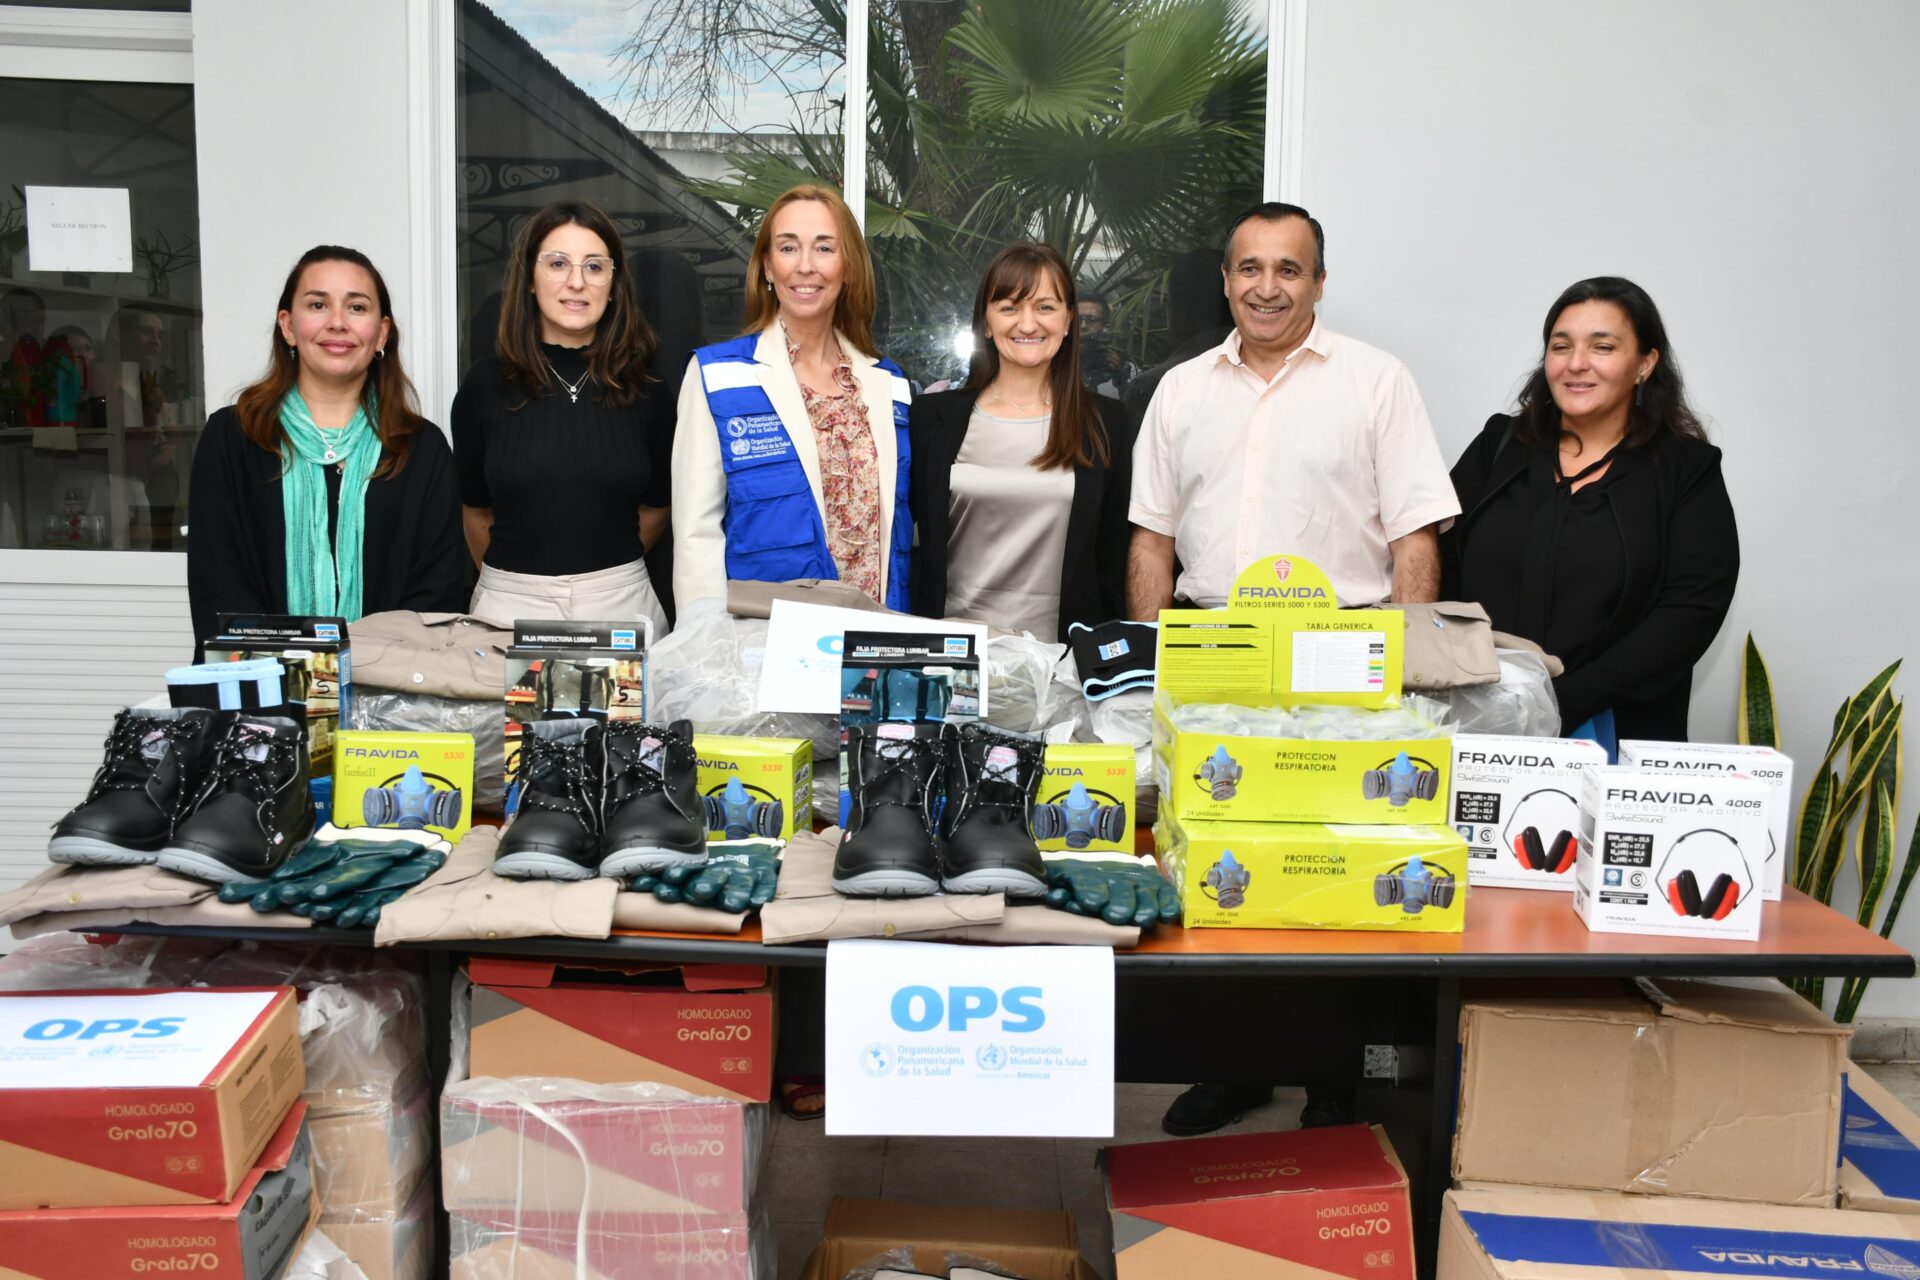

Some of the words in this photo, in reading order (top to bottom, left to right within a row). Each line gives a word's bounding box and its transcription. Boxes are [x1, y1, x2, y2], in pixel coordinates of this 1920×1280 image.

[747, 413, 780, 424] Organizació
[748, 421, 782, 429] Panamerican
[751, 435, 783, 445] Organización
[1238, 587, 1326, 598] FRAVIDA
[1306, 622, 1330, 630] TABLA
[1333, 623, 1374, 631] GENERICA
[345, 748, 419, 759] FRAVIDA
[1276, 751, 1337, 761] PROTECCION
[696, 759, 739, 771] AVIDA
[1275, 762, 1337, 771] RESPIRATORIA
[1458, 752, 1556, 769] FRAVIDA
[762, 764, 783, 772] 5330
[1041, 767, 1084, 777] VIDA
[1105, 768, 1127, 776] 5330
[1457, 764, 1531, 775] PROTECTOR
[1540, 768, 1581, 777] AUDITI
[1606, 788, 1714, 806] FRAVIDA
[1604, 802, 1687, 813] PROTECTOR
[1696, 807, 1761, 817] AUDITIVO
[1284, 855, 1346, 864] PROTECCION
[1282, 866, 1347, 876] RESPIRATORIA
[677, 1009, 752, 1020] HOMOLOGADO
[890, 985, 1046, 1033] OPS
[23, 1017, 188, 1040] OPS
[677, 1025, 752, 1041] Grafa70
[897, 1044, 960, 1056] Organización
[1009, 1045, 1064, 1056] Organización
[897, 1055, 965, 1065] Panamericana
[1009, 1056, 1041, 1066] Mundial
[1043, 1057, 1054, 1066] de
[1055, 1057, 1064, 1066] la
[1065, 1057, 1087, 1066] Salud
[897, 1066, 911, 1076] de
[912, 1066, 922, 1076] la
[923, 1067, 951, 1076] Salud
[105, 1102, 195, 1117] HOMOLOGADO
[108, 1120, 198, 1140] Grafa70
[650, 1140, 725, 1156] Grafa70
[1189, 1157, 1297, 1174] HOMOLOGADO
[1193, 1167, 1301, 1184] Grafa70
[1316, 1201, 1390, 1219] HOMOLOGADO
[1318, 1218, 1392, 1240] Grafa70
[128, 1236, 217, 1249] HOMOLOGADO
[130, 1253, 220, 1272] Grafa70
[1697, 1250, 1865, 1271] FRAVIDA
